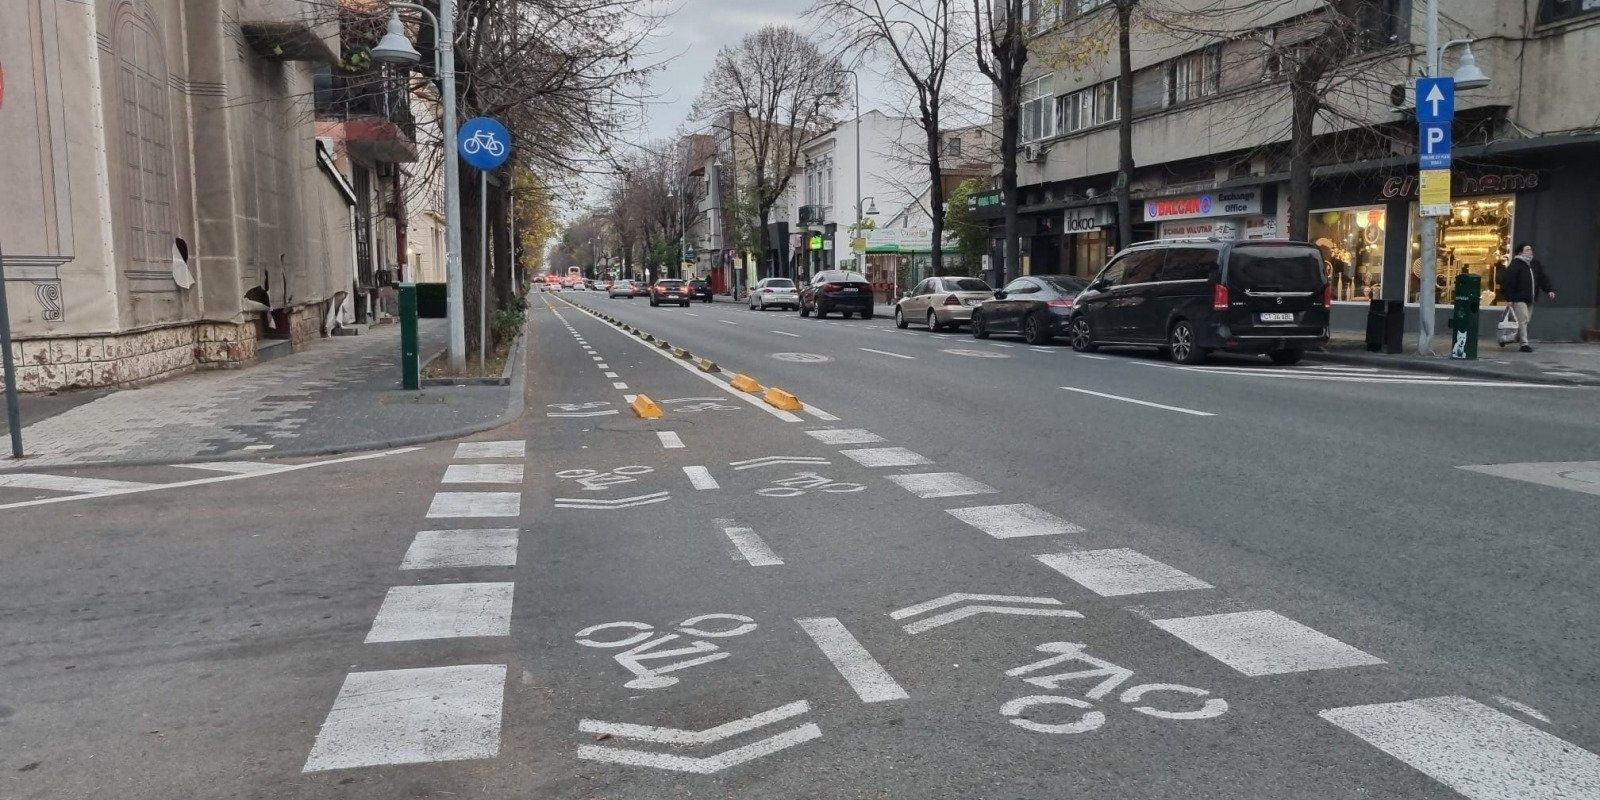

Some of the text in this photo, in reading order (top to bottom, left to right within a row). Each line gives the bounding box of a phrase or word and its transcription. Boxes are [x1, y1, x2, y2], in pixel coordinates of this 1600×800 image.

[1427, 127, 1444, 154] P
[1462, 171, 1538, 193] home
[1218, 191, 1255, 202] Exchange
[1158, 197, 1200, 216] BALCAN
[1225, 204, 1247, 213] Office
[1187, 225, 1213, 234] VALUTAR
